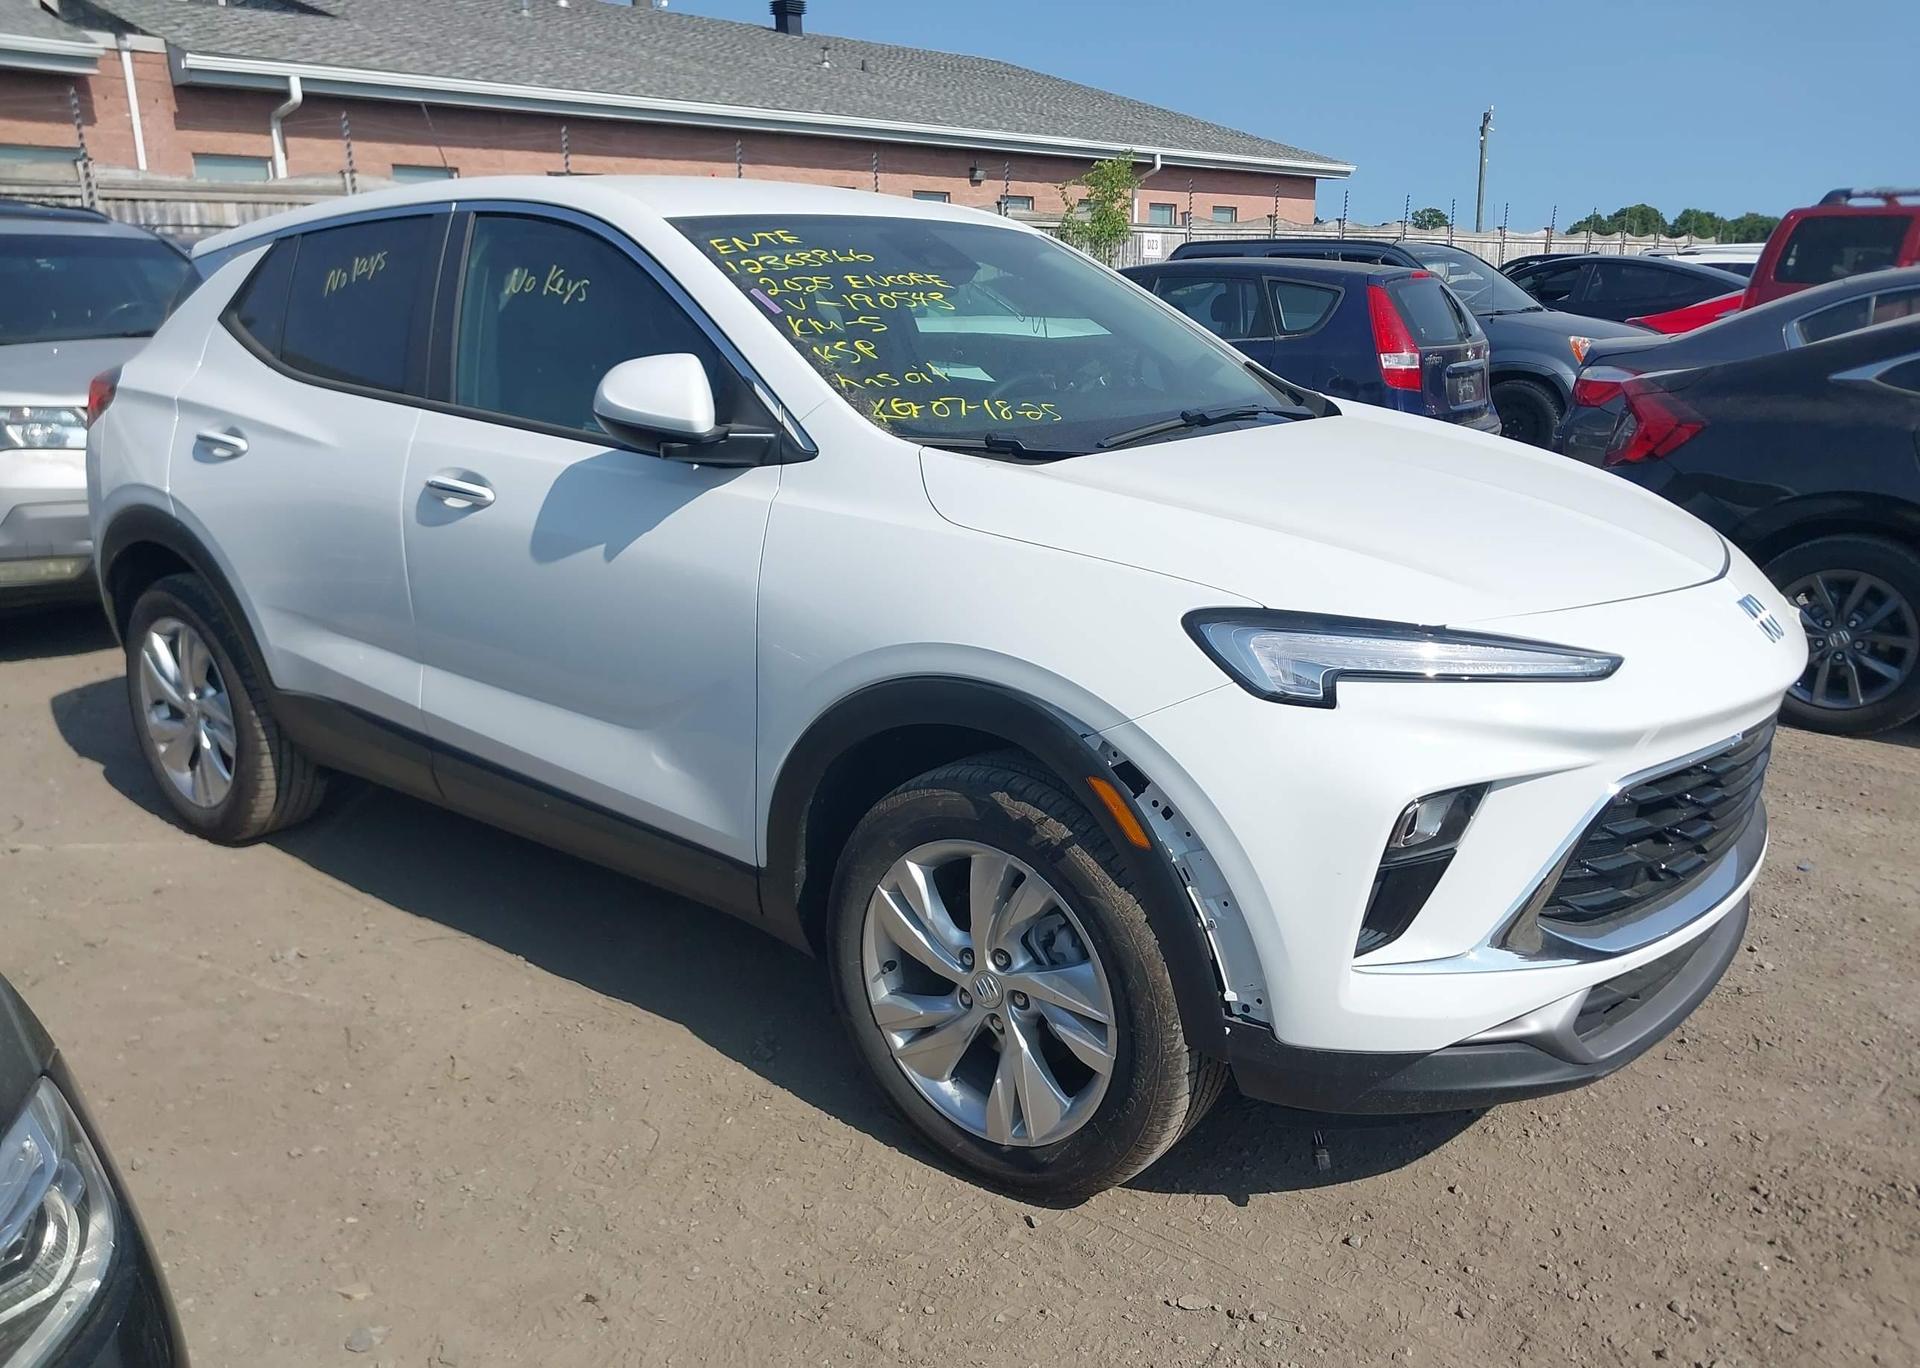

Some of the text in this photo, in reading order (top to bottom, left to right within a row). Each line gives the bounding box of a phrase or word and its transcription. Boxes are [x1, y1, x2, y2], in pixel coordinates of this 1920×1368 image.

[324, 268, 348, 297] No
[504, 264, 591, 305] No Keys
[758, 272, 956, 296] 2025 ENCORE
